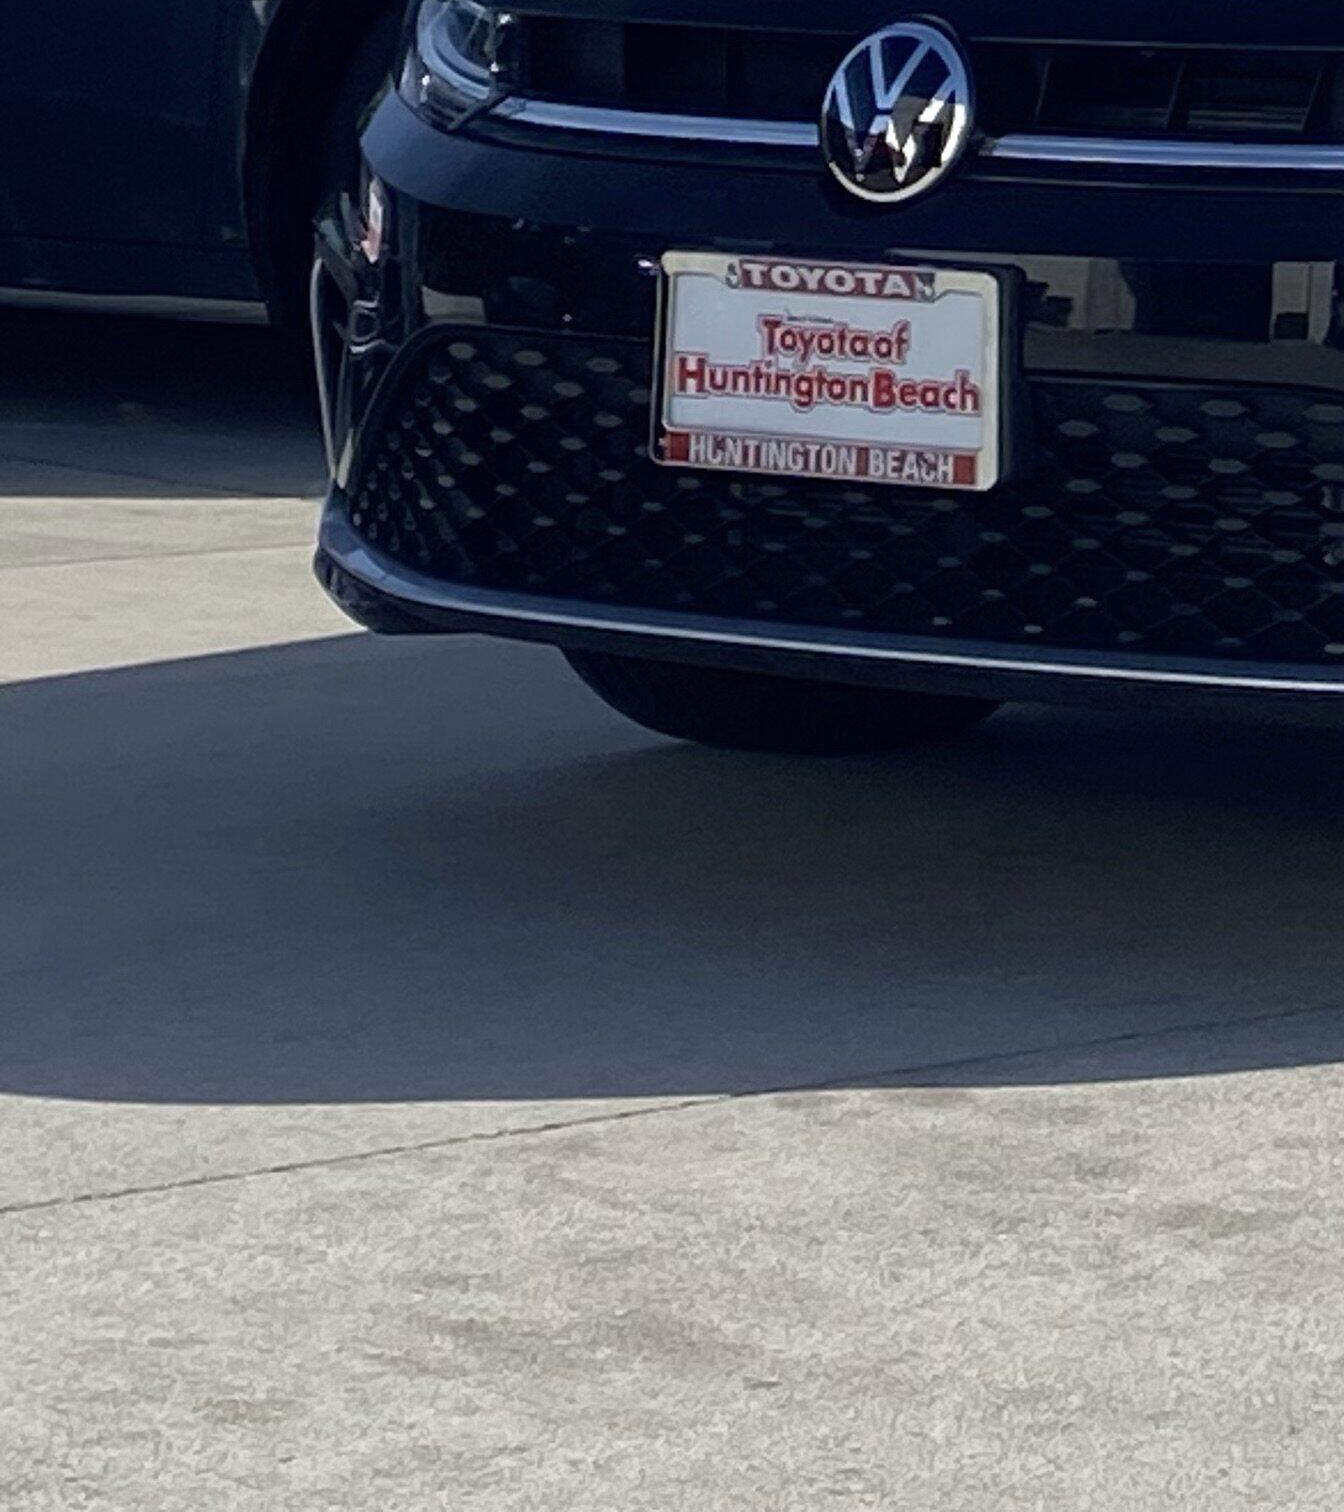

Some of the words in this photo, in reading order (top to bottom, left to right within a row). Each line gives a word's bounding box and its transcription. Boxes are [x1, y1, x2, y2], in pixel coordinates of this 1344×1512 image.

[745, 262, 912, 298] TOYOTA
[760, 317, 870, 361] Toyota
[871, 321, 909, 362] of
[676, 355, 868, 408] Huntington
[869, 368, 980, 415] Beach
[689, 435, 856, 471] HUNTINGTON
[869, 449, 954, 484] BEACH
